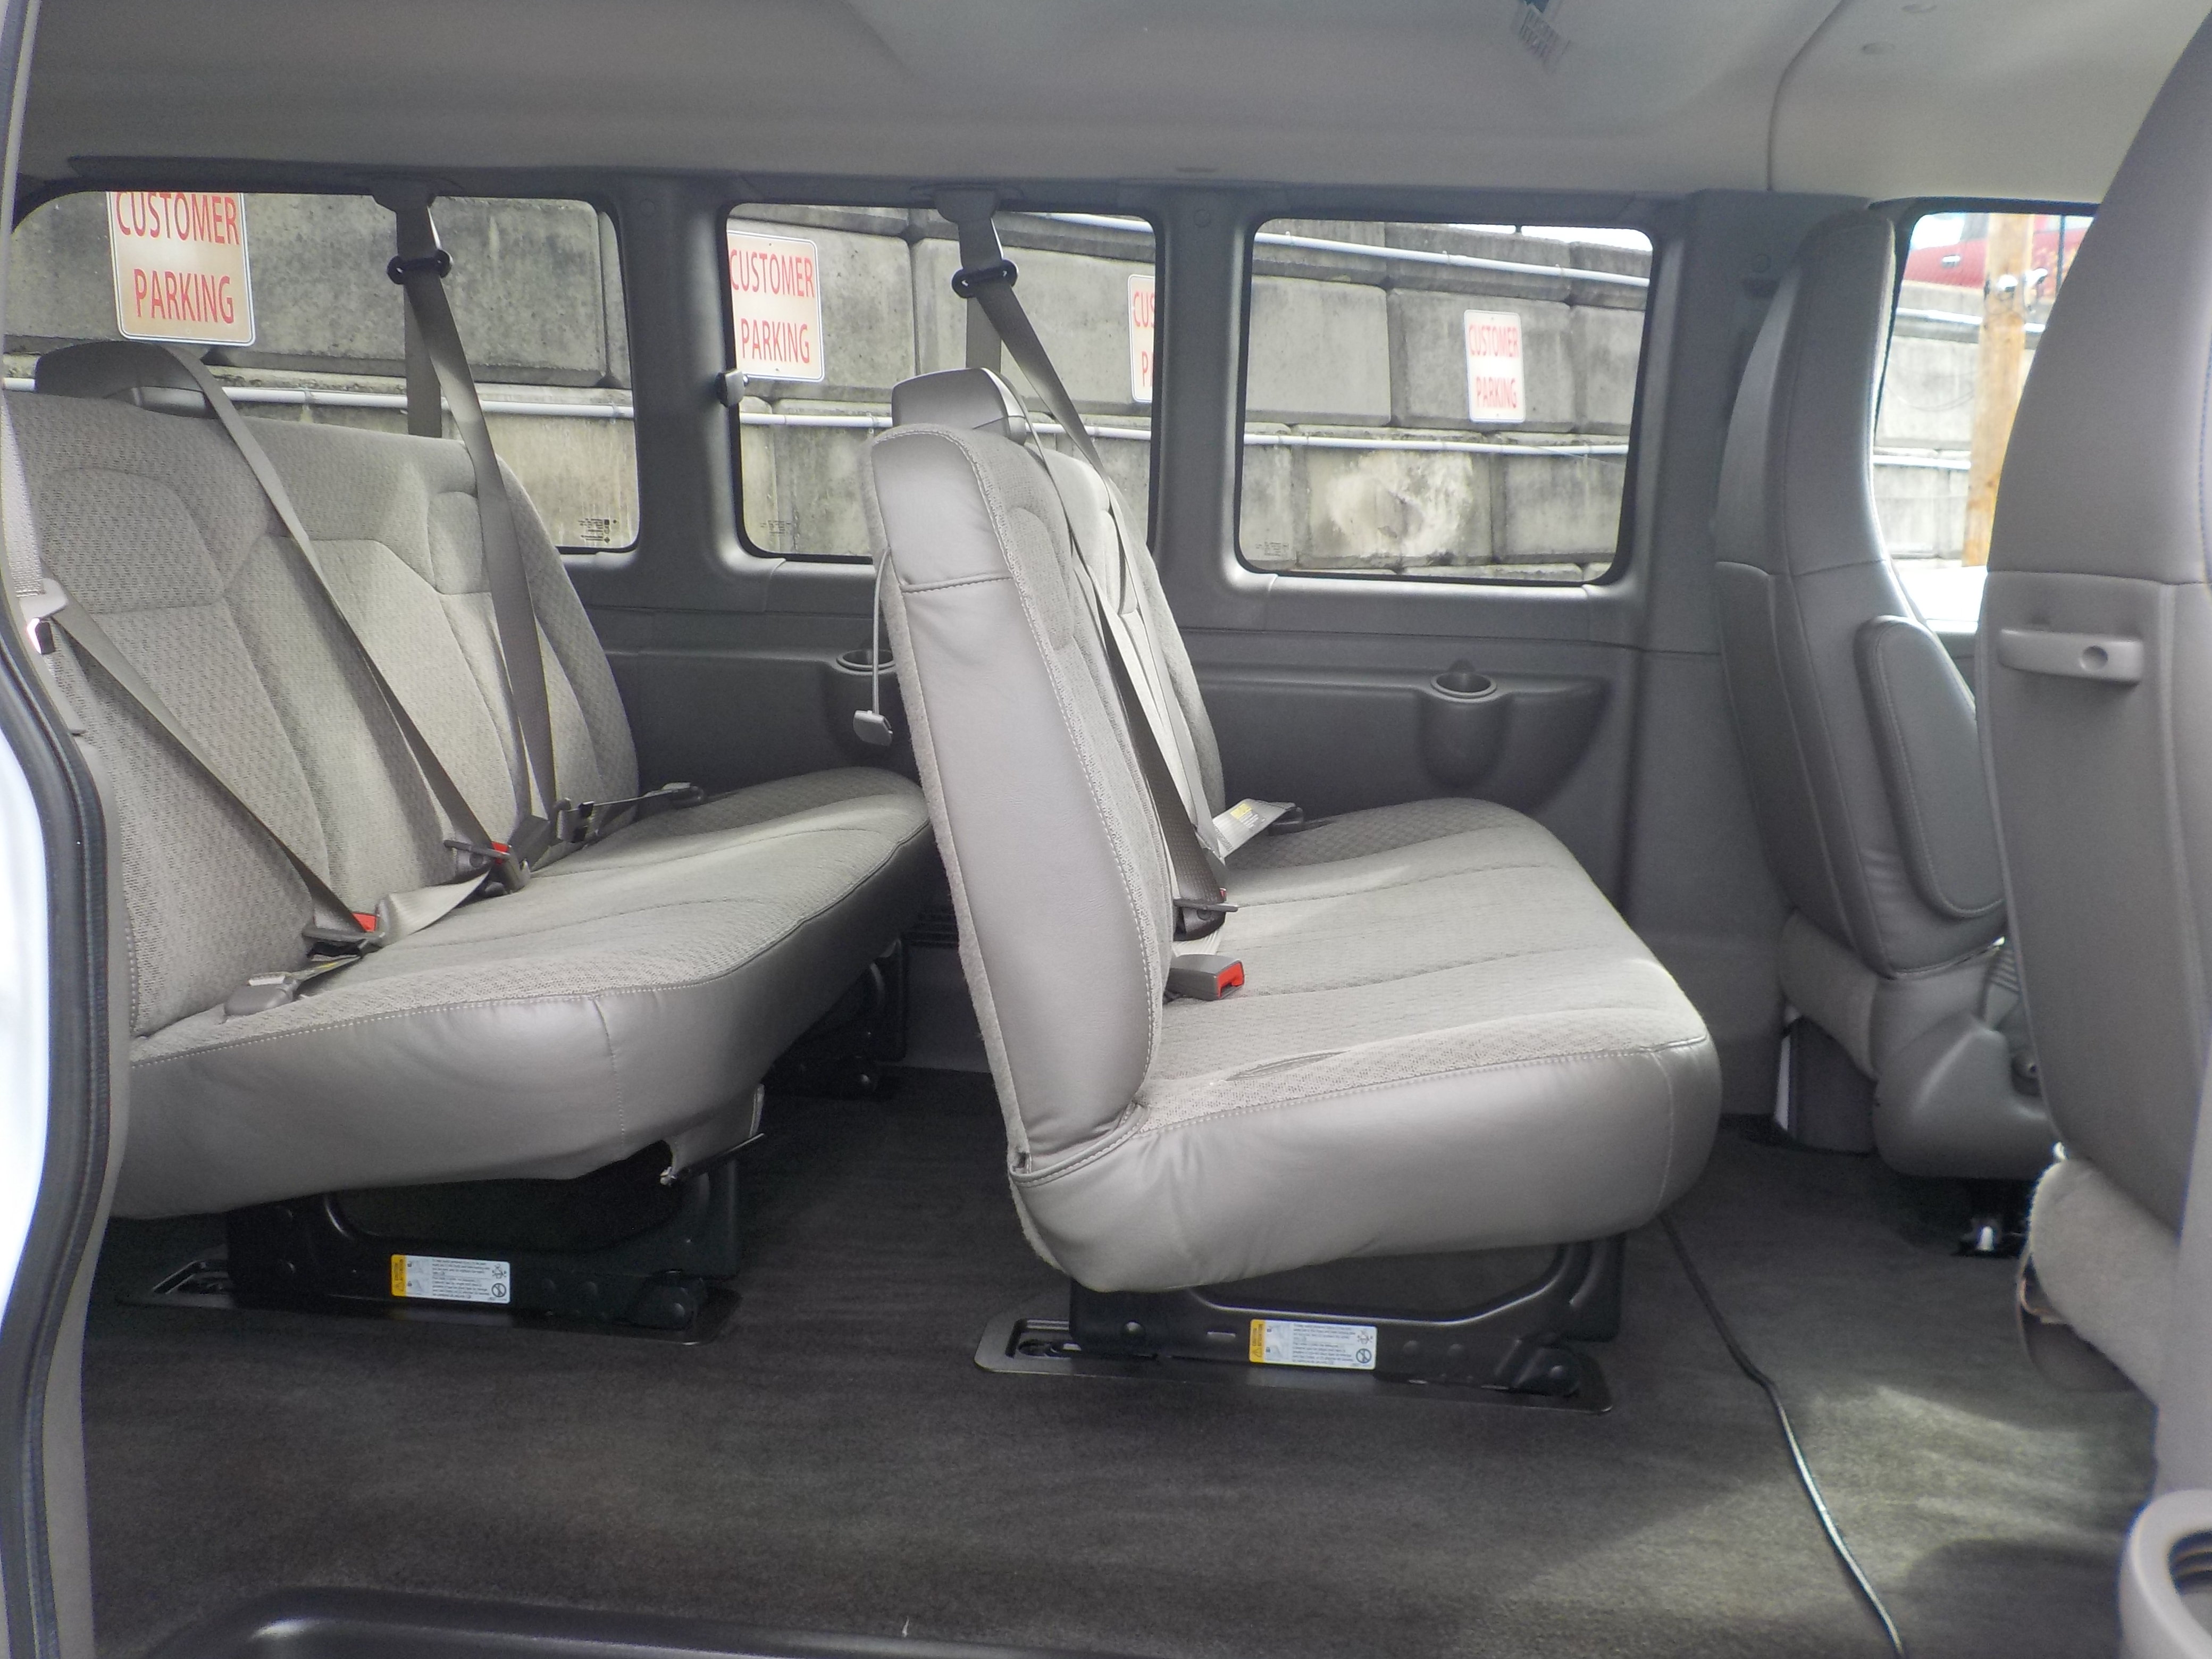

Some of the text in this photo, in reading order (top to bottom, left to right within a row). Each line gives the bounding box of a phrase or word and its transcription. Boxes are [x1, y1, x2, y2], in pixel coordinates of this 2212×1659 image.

[115, 192, 240, 245] CUSTOMER
[134, 268, 234, 324] PARKING
[730, 249, 814, 298] CUSTOMER
[741, 319, 810, 364] PARKING
[1469, 325, 1519, 357] CUSTOMER
[1476, 376, 1516, 409] PARKING
